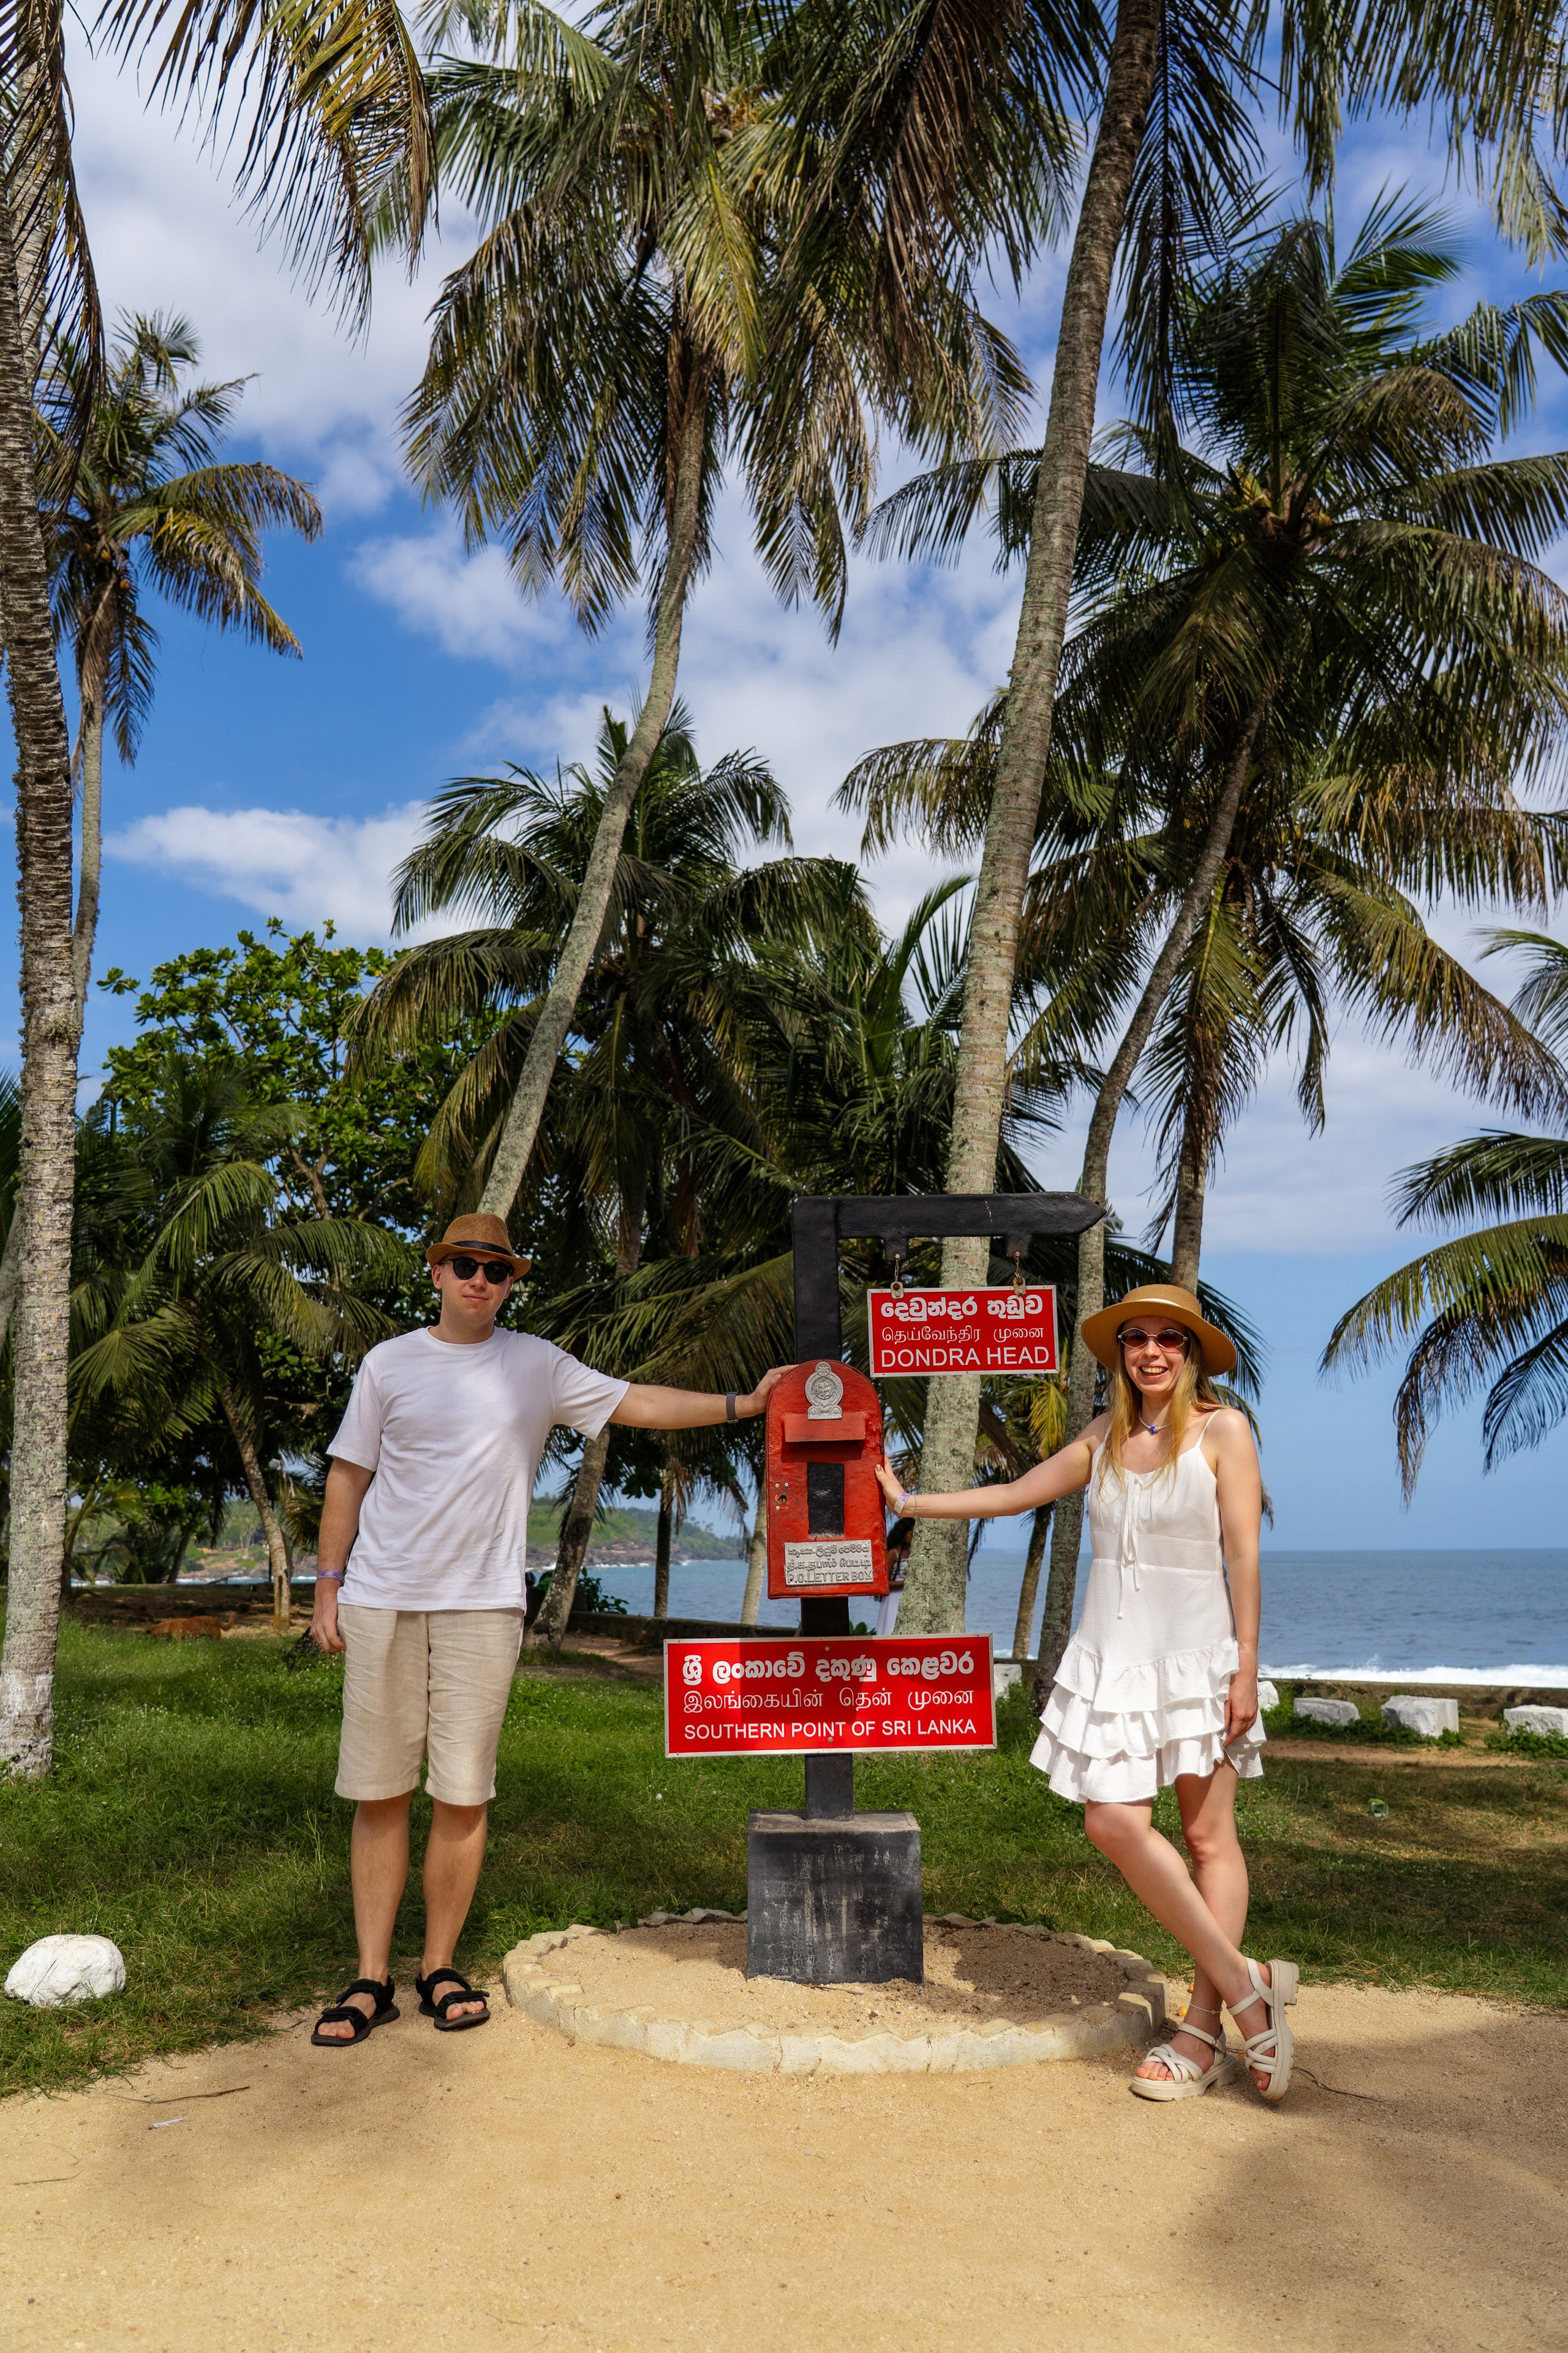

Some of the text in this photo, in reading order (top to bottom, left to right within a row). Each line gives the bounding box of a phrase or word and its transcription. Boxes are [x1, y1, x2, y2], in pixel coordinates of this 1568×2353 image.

[881, 1294, 1042, 1321] දෙවුන්දර තුඩුව
[883, 1325, 1044, 1345] தெய்வேந்திர முனை
[881, 1346, 1049, 1367] DONDRA HEAD
[851, 1570, 872, 1581] BOX
[712, 1652, 805, 1684] ලංකාවේ
[816, 1655, 876, 1682] දකුණු
[887, 1651, 974, 1680] කෙළවර
[684, 1688, 973, 1713] இலங்கையின் தென் முனை
[685, 1719, 976, 1739] SOUTHERN POINT OF SRI LANKA
